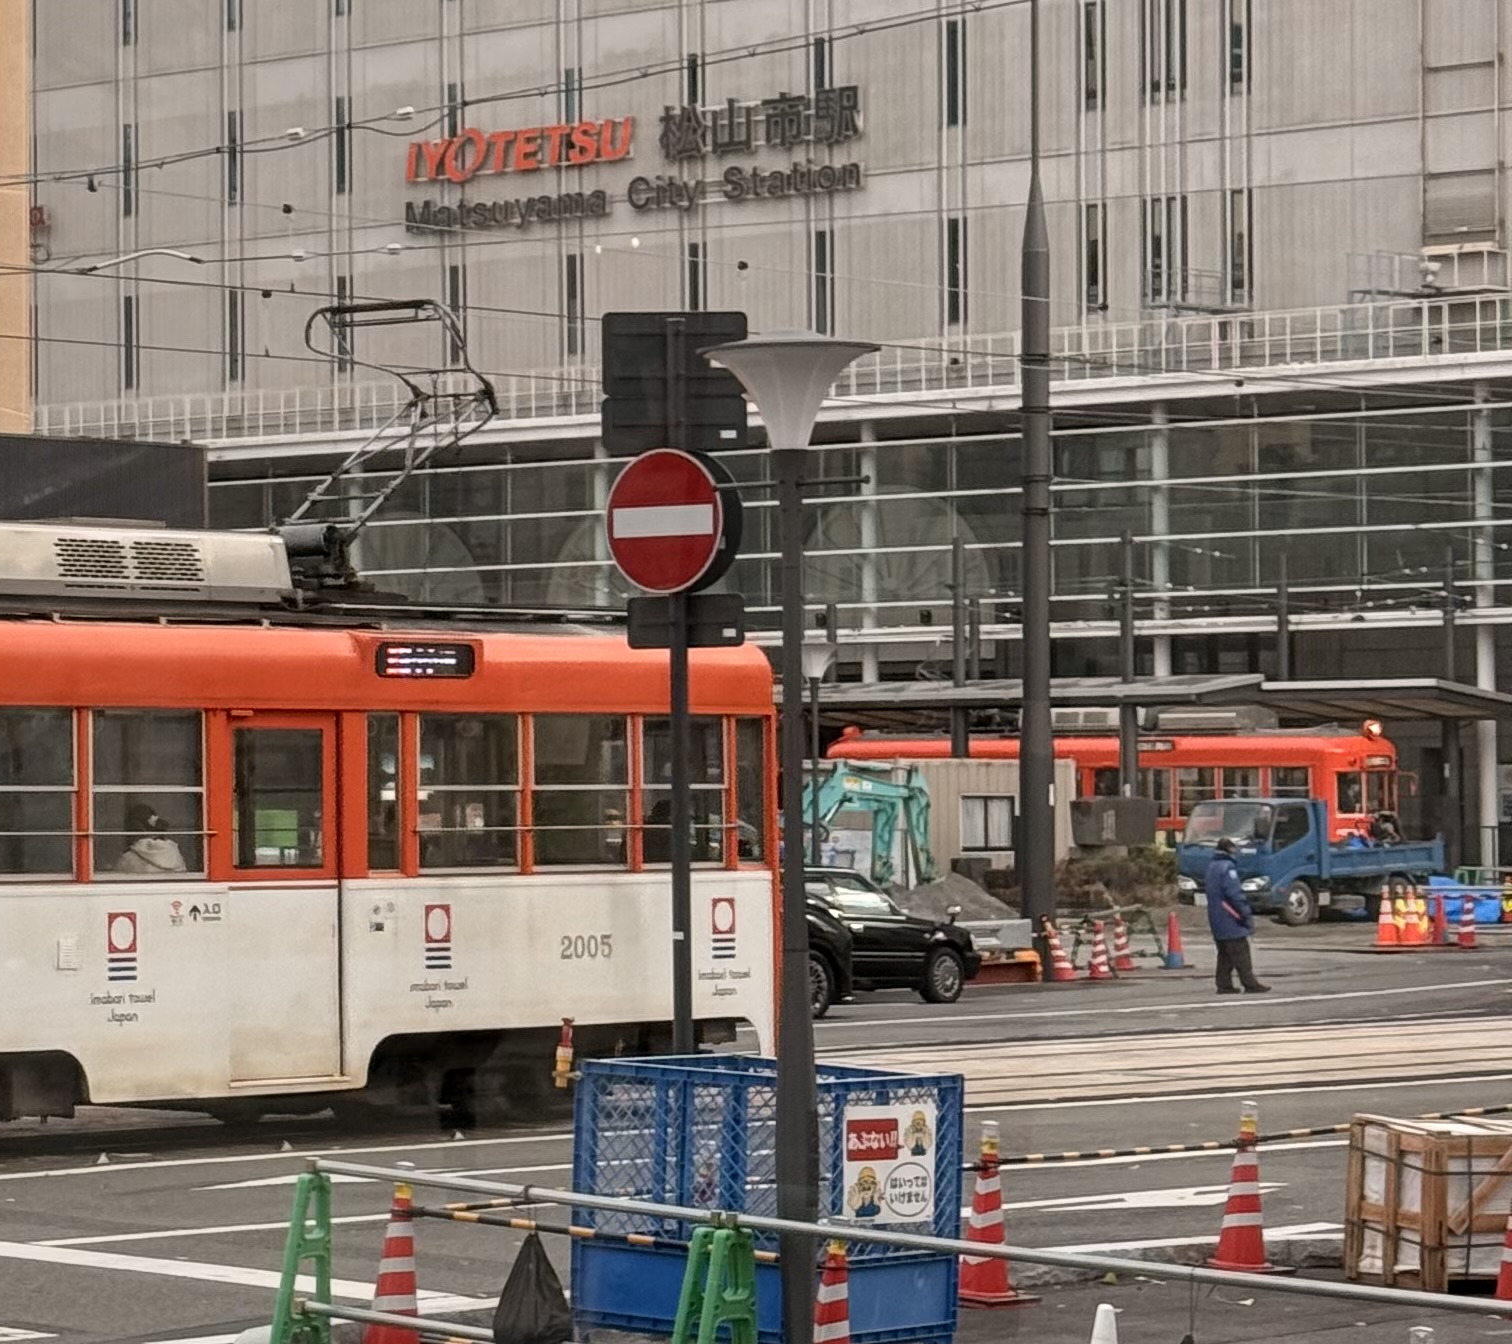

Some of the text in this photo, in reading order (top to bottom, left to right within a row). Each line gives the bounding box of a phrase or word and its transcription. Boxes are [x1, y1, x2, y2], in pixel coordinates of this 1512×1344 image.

[405, 116, 635, 183] IYOTETSU
[659, 85, 861, 160] 松山市駅
[405, 158, 862, 233] Matsuyama City Station
[560, 934, 613, 960] 2005
[107, 1008, 138, 1027] Japan
